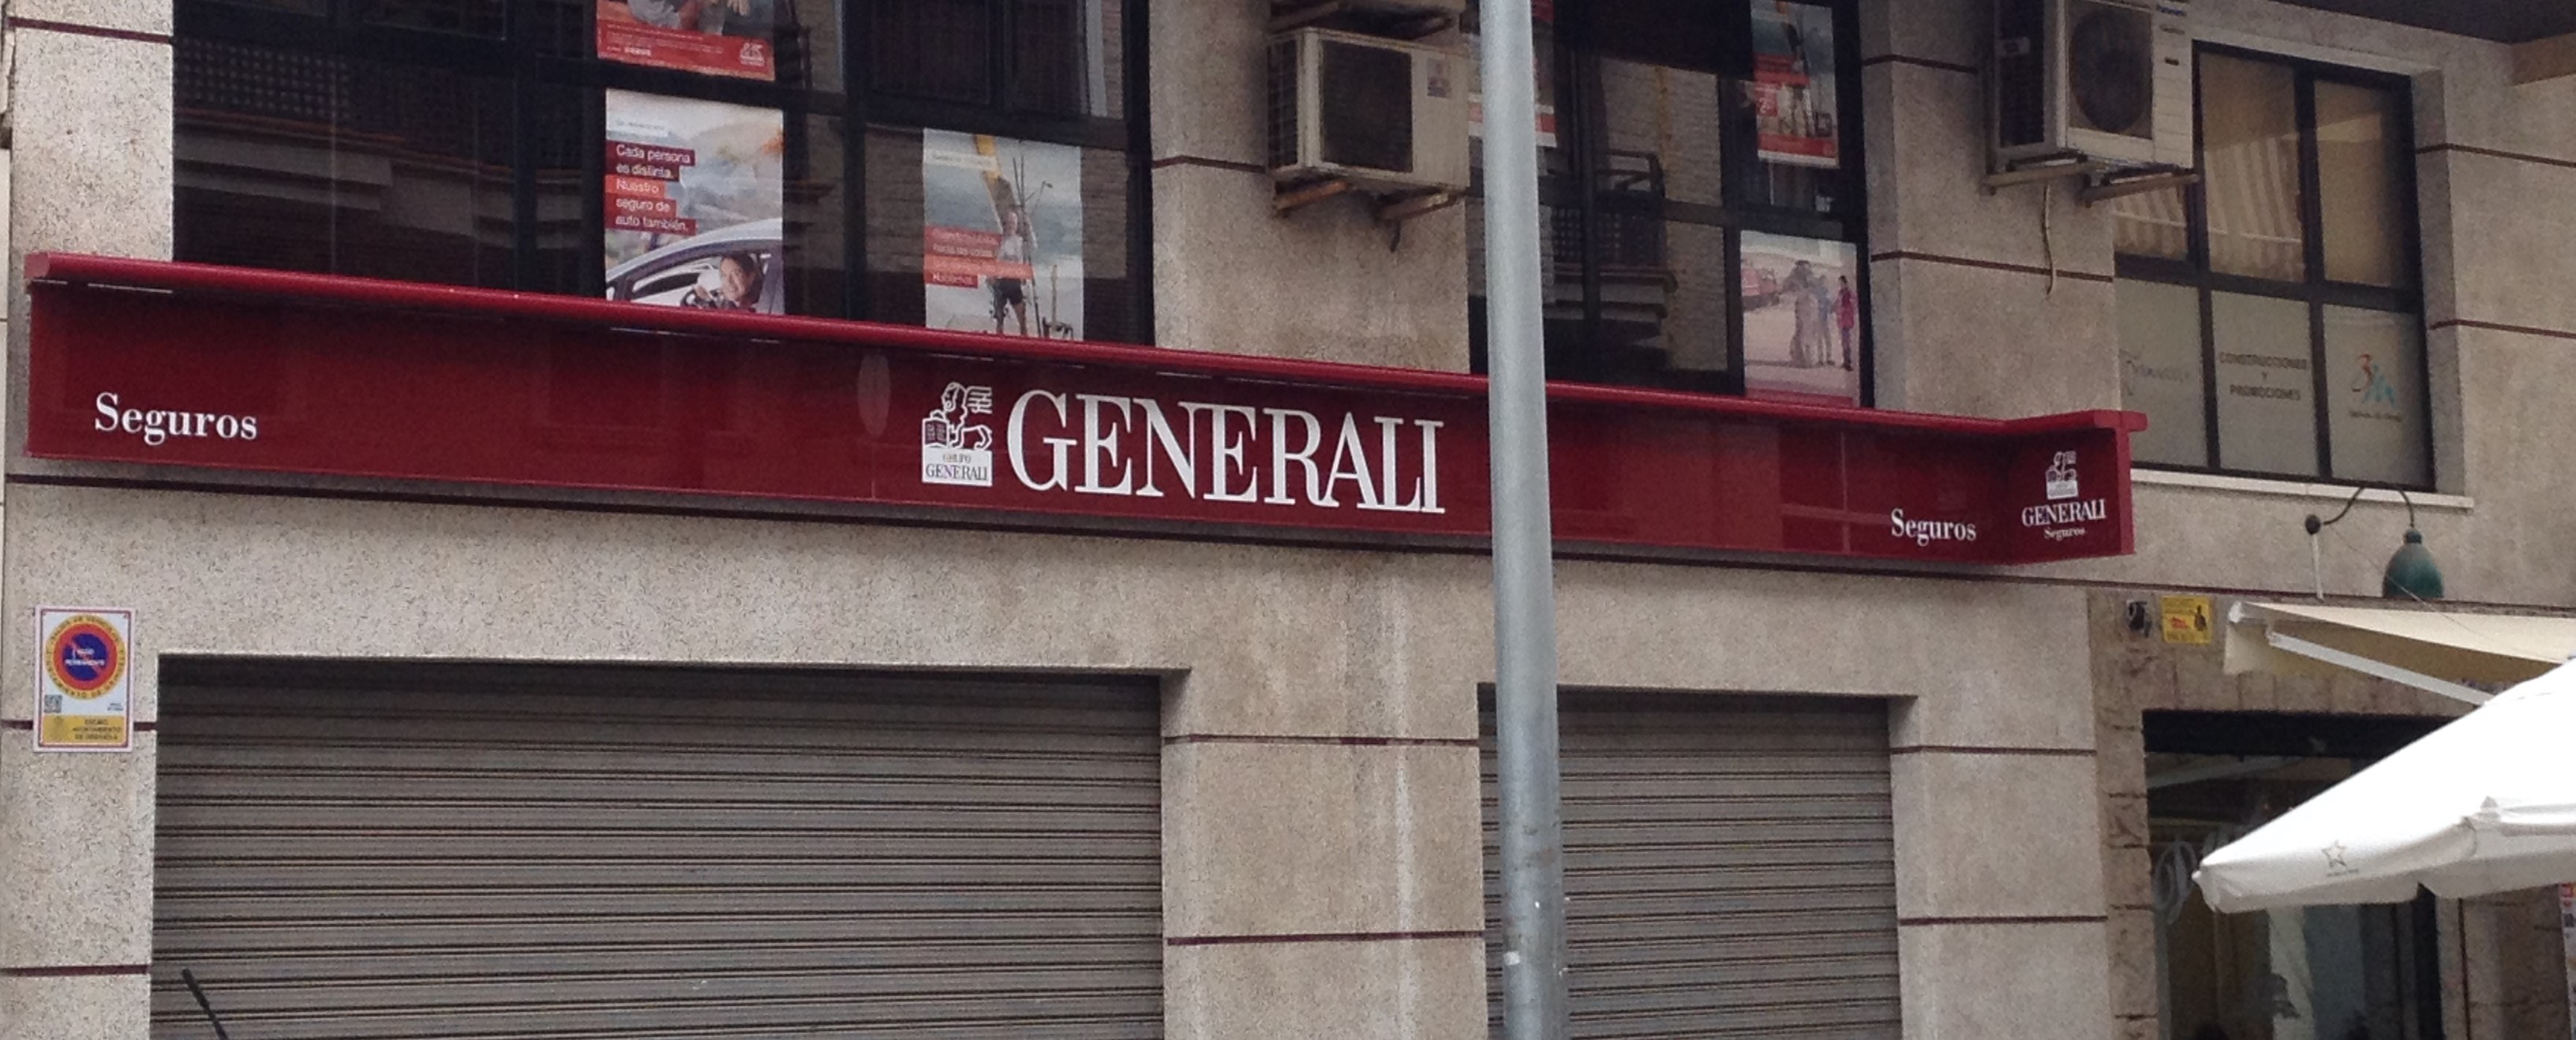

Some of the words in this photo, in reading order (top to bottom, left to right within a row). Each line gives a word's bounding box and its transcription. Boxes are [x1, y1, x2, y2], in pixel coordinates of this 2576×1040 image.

[616, 144, 645, 159] Cada
[647, 150, 691, 163] persona
[616, 163, 630, 174] es
[616, 178, 659, 193] Nuestro
[616, 198, 653, 211] seguro
[656, 201, 670, 213] de
[616, 215, 640, 226] auto
[2229, 383, 2301, 401] PROMOCIONES
[94, 391, 259, 447] Seguros
[1007, 389, 1445, 514] GENERALI
[926, 463, 988, 481] GENERALI
[2021, 498, 2107, 528] GENERALI
[1890, 507, 1977, 548] Seguros
[2044, 526, 2085, 541] Seguros
